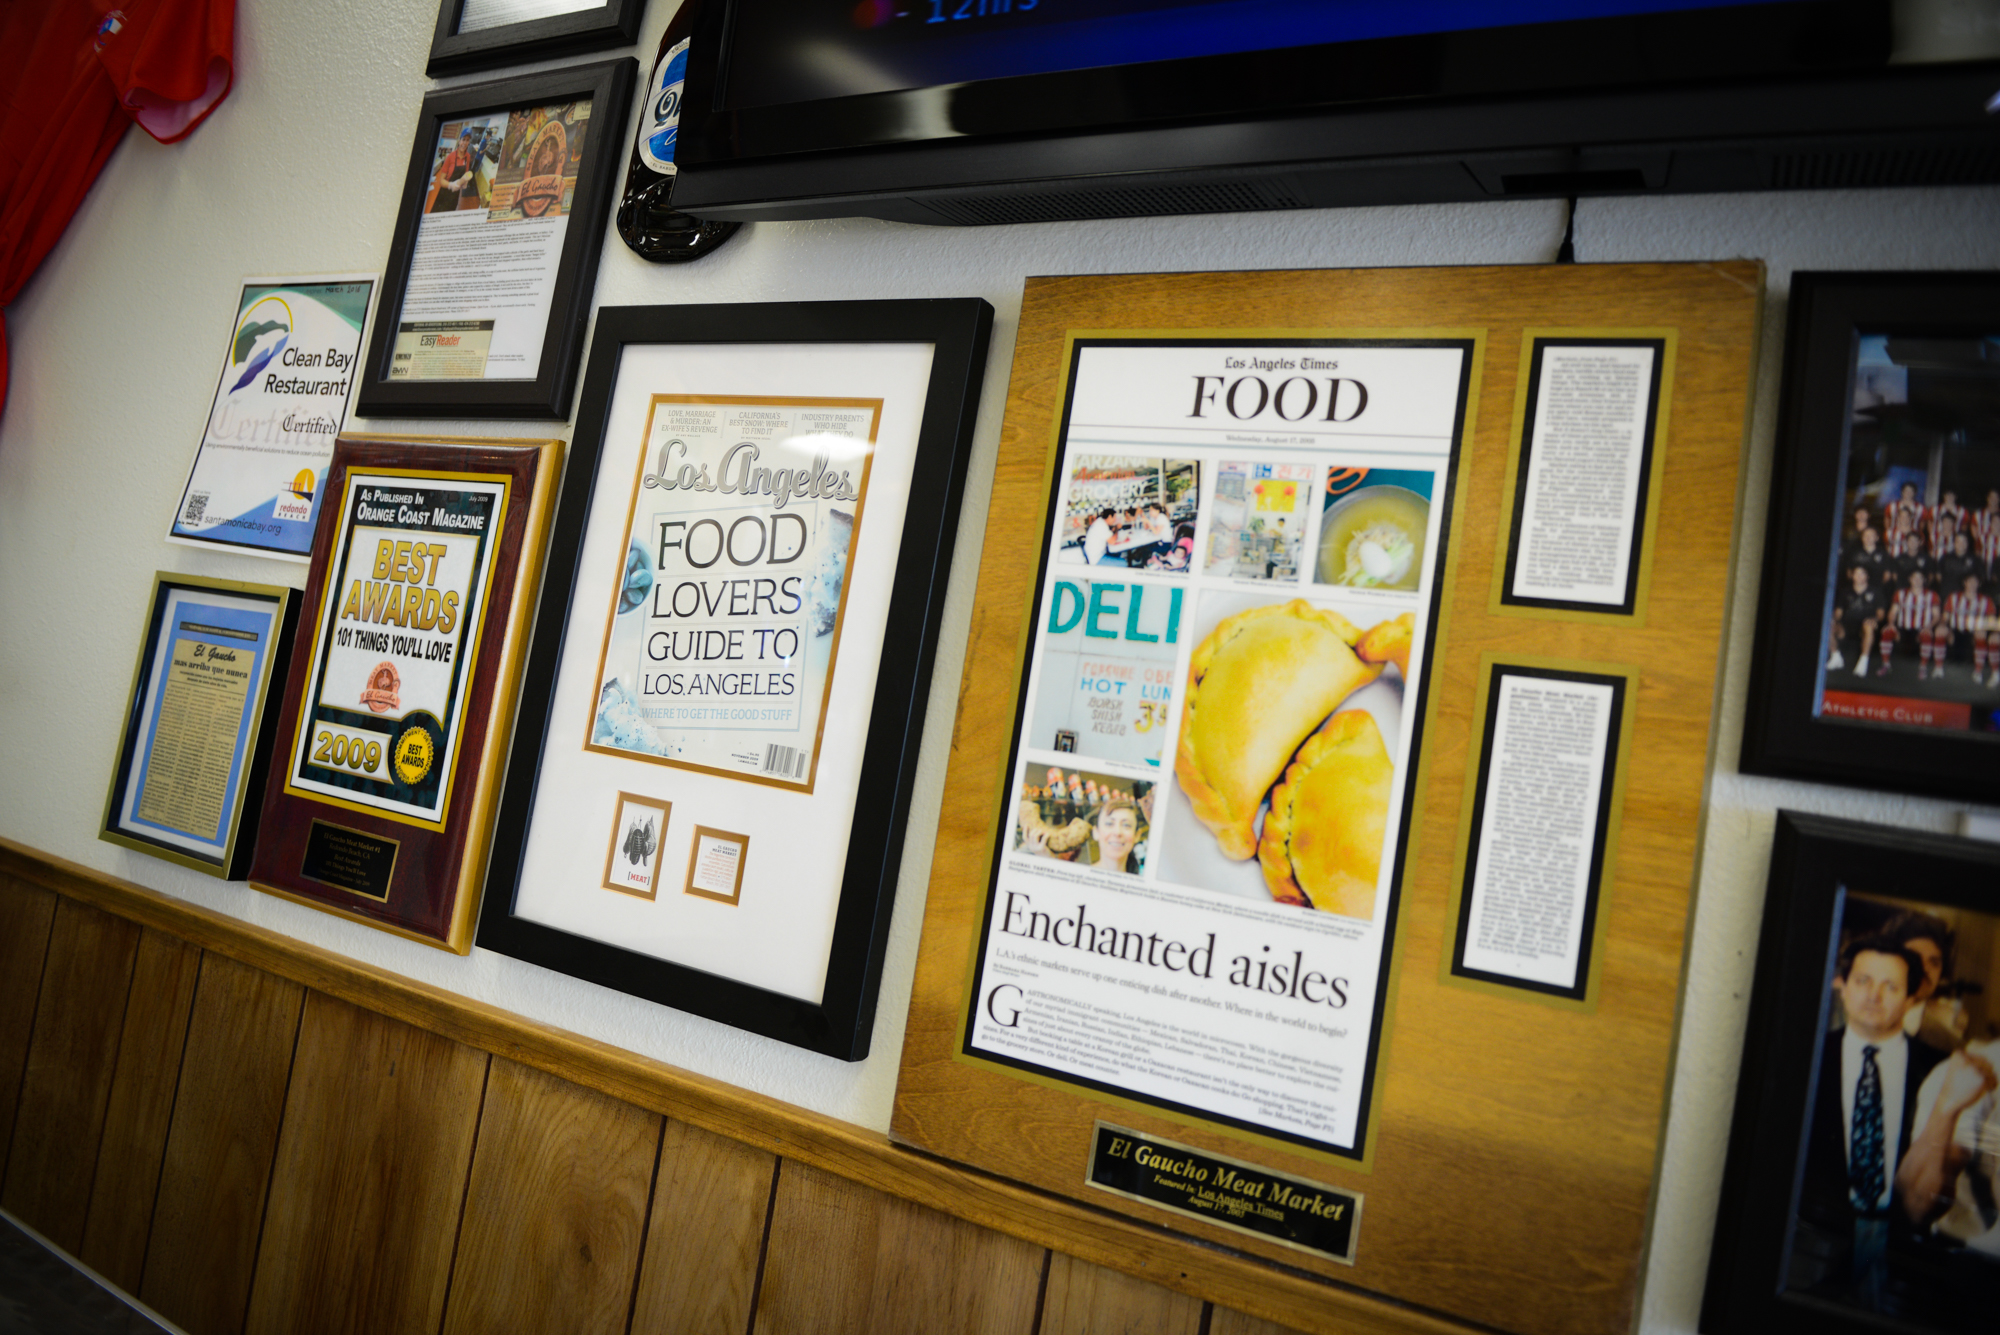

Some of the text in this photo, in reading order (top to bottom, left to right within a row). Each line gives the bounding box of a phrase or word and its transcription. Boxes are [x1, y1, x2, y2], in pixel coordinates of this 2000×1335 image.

[521, 177, 558, 195] El Gaucho
[326, 286, 344, 294] March
[282, 347, 353, 372] Clean Bay
[1225, 356, 1338, 372] Los Angeles Times
[264, 374, 347, 396] Restaurant
[1186, 375, 1369, 422] FOOD
[282, 414, 338, 435] Certified
[668, 410, 684, 418] LOVE,
[739, 411, 781, 420] CALIFORNIA'S
[802, 414, 864, 422] INDUSTRY PARENTS
[662, 424, 718, 434] EX-WIFE'S REVENGE
[1226, 434, 1264, 445] Wednesday,
[1266, 436, 1288, 445] August
[643, 438, 859, 510] Los Angeles
[1069, 480, 1149, 502] GROCERY
[280, 504, 308, 514] redondo
[204, 516, 282, 536] santamonicabay.org
[658, 513, 807, 570] FOOD
[372, 538, 447, 586] BEST
[341, 580, 460, 634] AWARDS
[651, 577, 802, 618] LOVERS
[1048, 581, 1184, 644] DELI
[194, 644, 236, 662] El Gaucho
[337, 627, 452, 663] 101 THINGS YOU'LL LOVE
[648, 628, 799, 661] GUIDE TO
[188, 662, 210, 672] arriba
[212, 666, 224, 675] que
[226, 670, 248, 678] nunca
[644, 673, 795, 696] LOS ANGELES
[1081, 678, 1172, 700] HOT LUN
[374, 692, 396, 702] Gaucho
[642, 708, 792, 721] WHERE TO GET THE GOOD STUFF
[314, 730, 382, 773] 2009
[396, 730, 420, 759] COMMITMENT
[408, 744, 422, 756] BEST
[397, 764, 410, 780] VISION
[401, 754, 424, 768] AWARDS
[998, 891, 1218, 980] Enchanted
[1229, 946, 1349, 1010] aisles
[987, 984, 1024, 1028] G
[1016, 953, 1039, 965] ethnic
[1040, 960, 1068, 972] markets
[1070, 967, 1090, 978] serve
[1091, 972, 1102, 982] up
[1102, 975, 1117, 984] one
[1118, 979, 1150, 994] enticing
[1150, 984, 1167, 996] dish
[1168, 989, 1188, 1000] after
[1188, 996, 1221, 1008] another.
[1224, 1001, 1253, 1016] Where
[1254, 1010, 1263, 1019] in
[1264, 1011, 1279, 1022] the
[1281, 1017, 1306, 1029] world
[1307, 1022, 1317, 1031] to
[1318, 1023, 1347, 1038] begin?
[1028, 989, 1092, 1010] ASTRONOMICALLY
[1108, 1137, 1344, 1221] El Gaucho Meat Market
[1154, 1174, 1284, 1220] Featured In: Los Angeles Times
[1188, 1196, 1213, 1208] August
[1214, 1202, 1226, 1214] 17,
